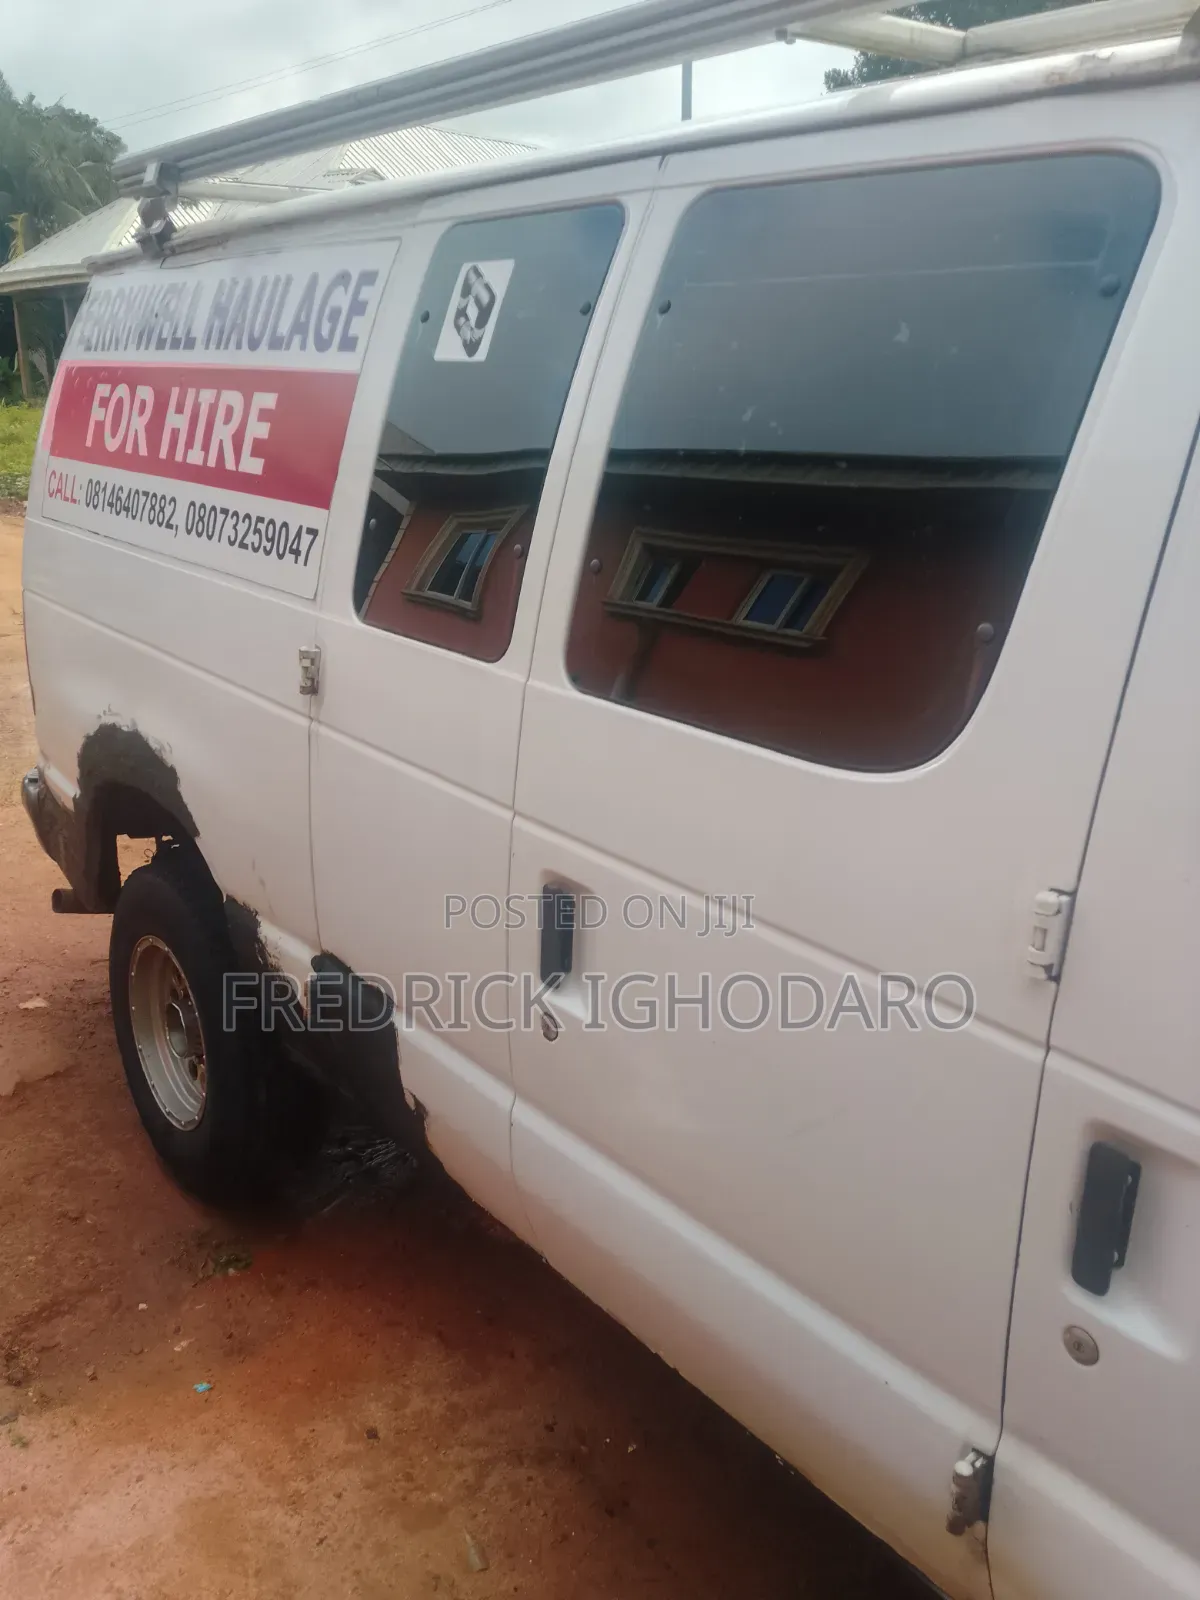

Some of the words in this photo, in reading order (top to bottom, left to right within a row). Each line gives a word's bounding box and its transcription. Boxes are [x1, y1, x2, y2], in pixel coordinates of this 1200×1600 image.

[203, 268, 380, 354] HAULAGE
[85, 382, 155, 457] FOR
[158, 385, 279, 476] HIRE
[47, 469, 83, 506] CALL:
[84, 477, 179, 539] 08146407882,
[185, 500, 319, 567] 08073259047
